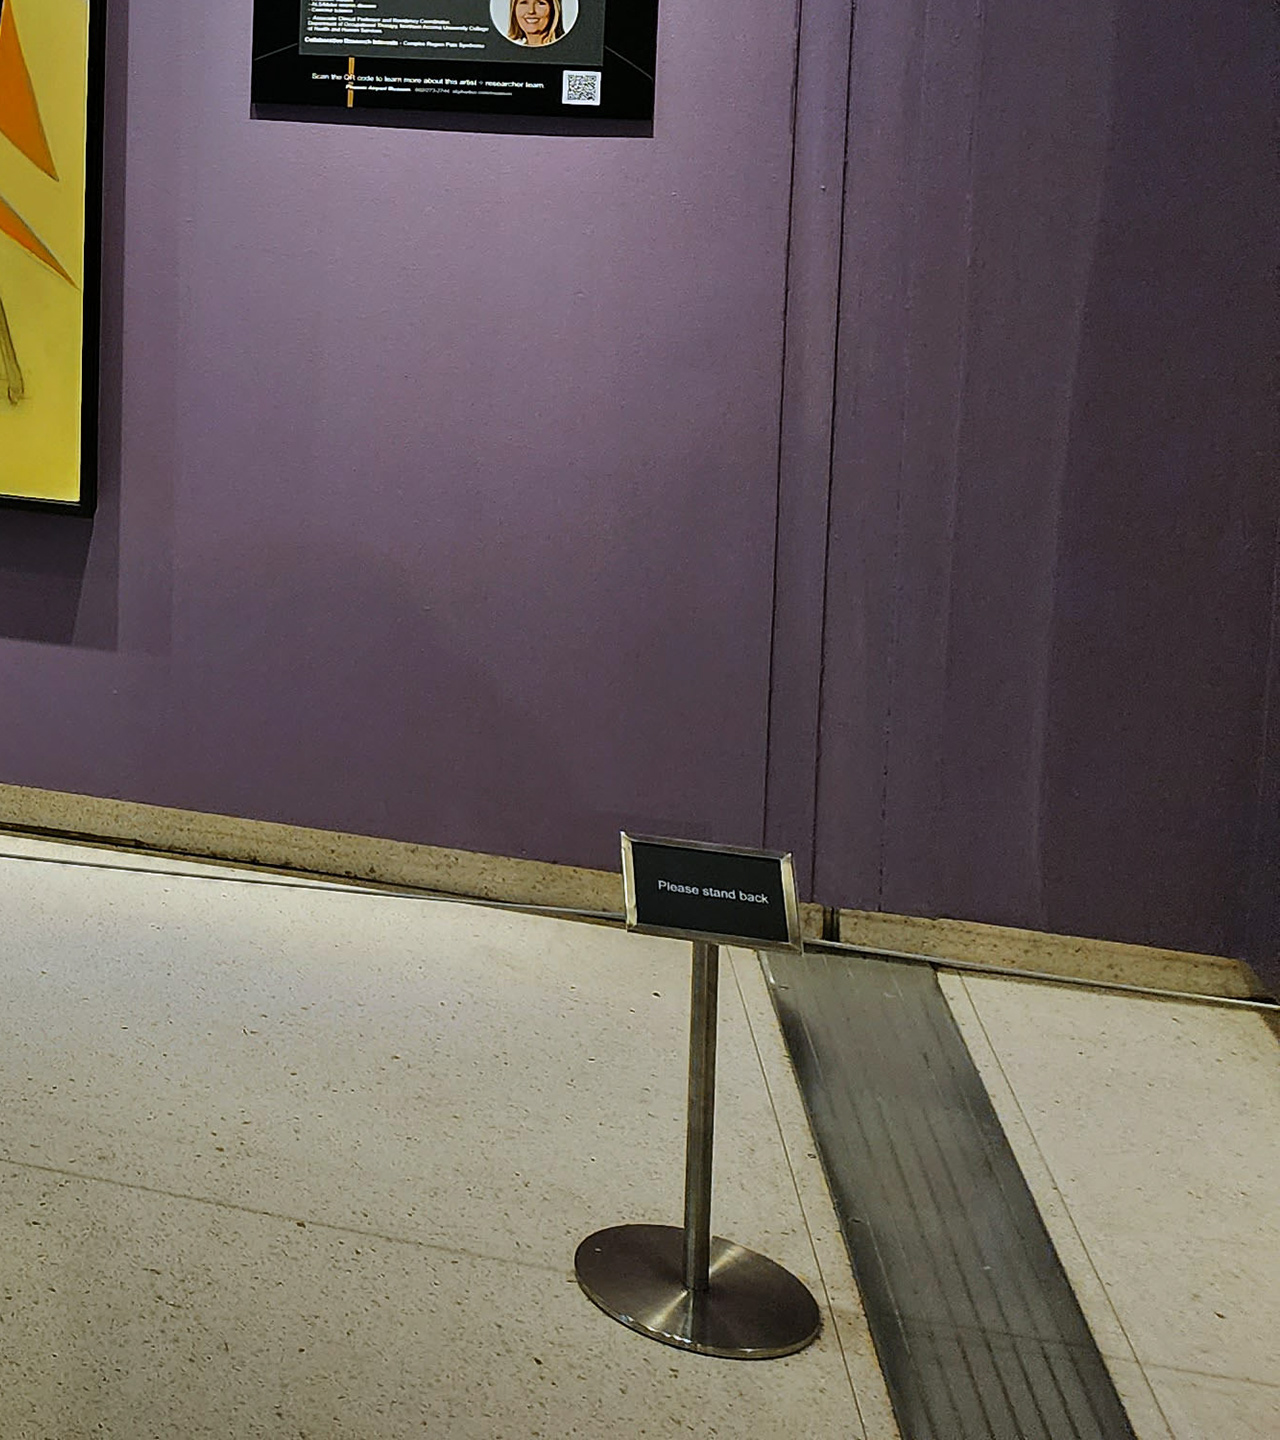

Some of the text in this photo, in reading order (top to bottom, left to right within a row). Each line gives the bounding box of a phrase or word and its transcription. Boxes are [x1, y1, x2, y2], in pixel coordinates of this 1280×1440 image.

[658, 879, 769, 904] Please stand back
